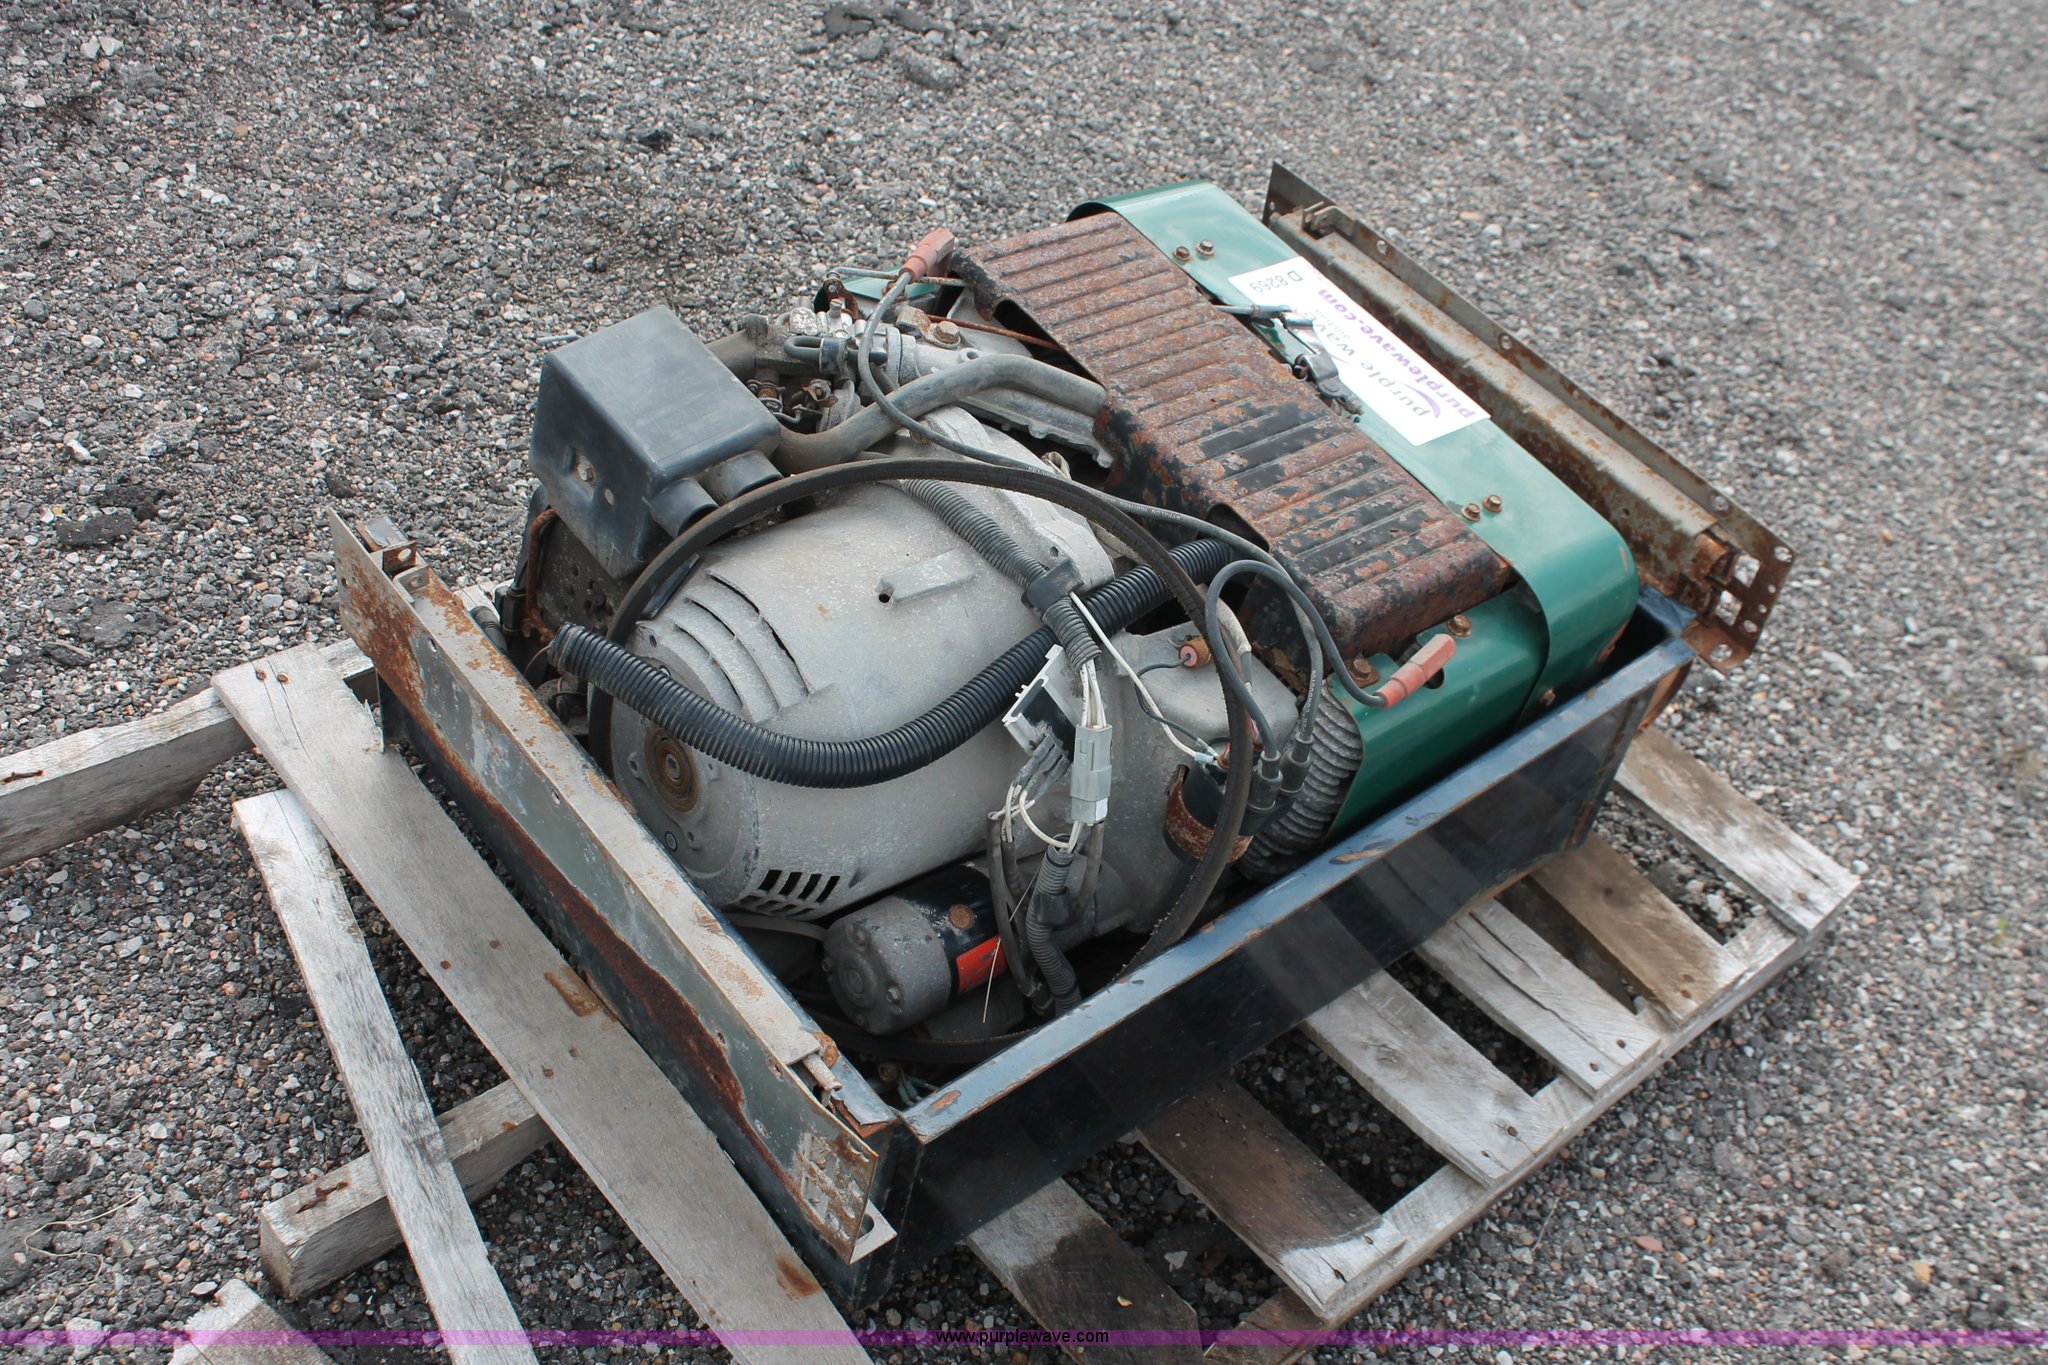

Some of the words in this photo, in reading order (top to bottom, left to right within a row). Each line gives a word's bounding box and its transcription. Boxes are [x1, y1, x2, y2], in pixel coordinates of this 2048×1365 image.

[1250, 275, 1288, 293] 8269
[1288, 270, 1303, 282] D
[1318, 289, 1475, 418] purplewave.com
[1361, 361, 1430, 416] purple
